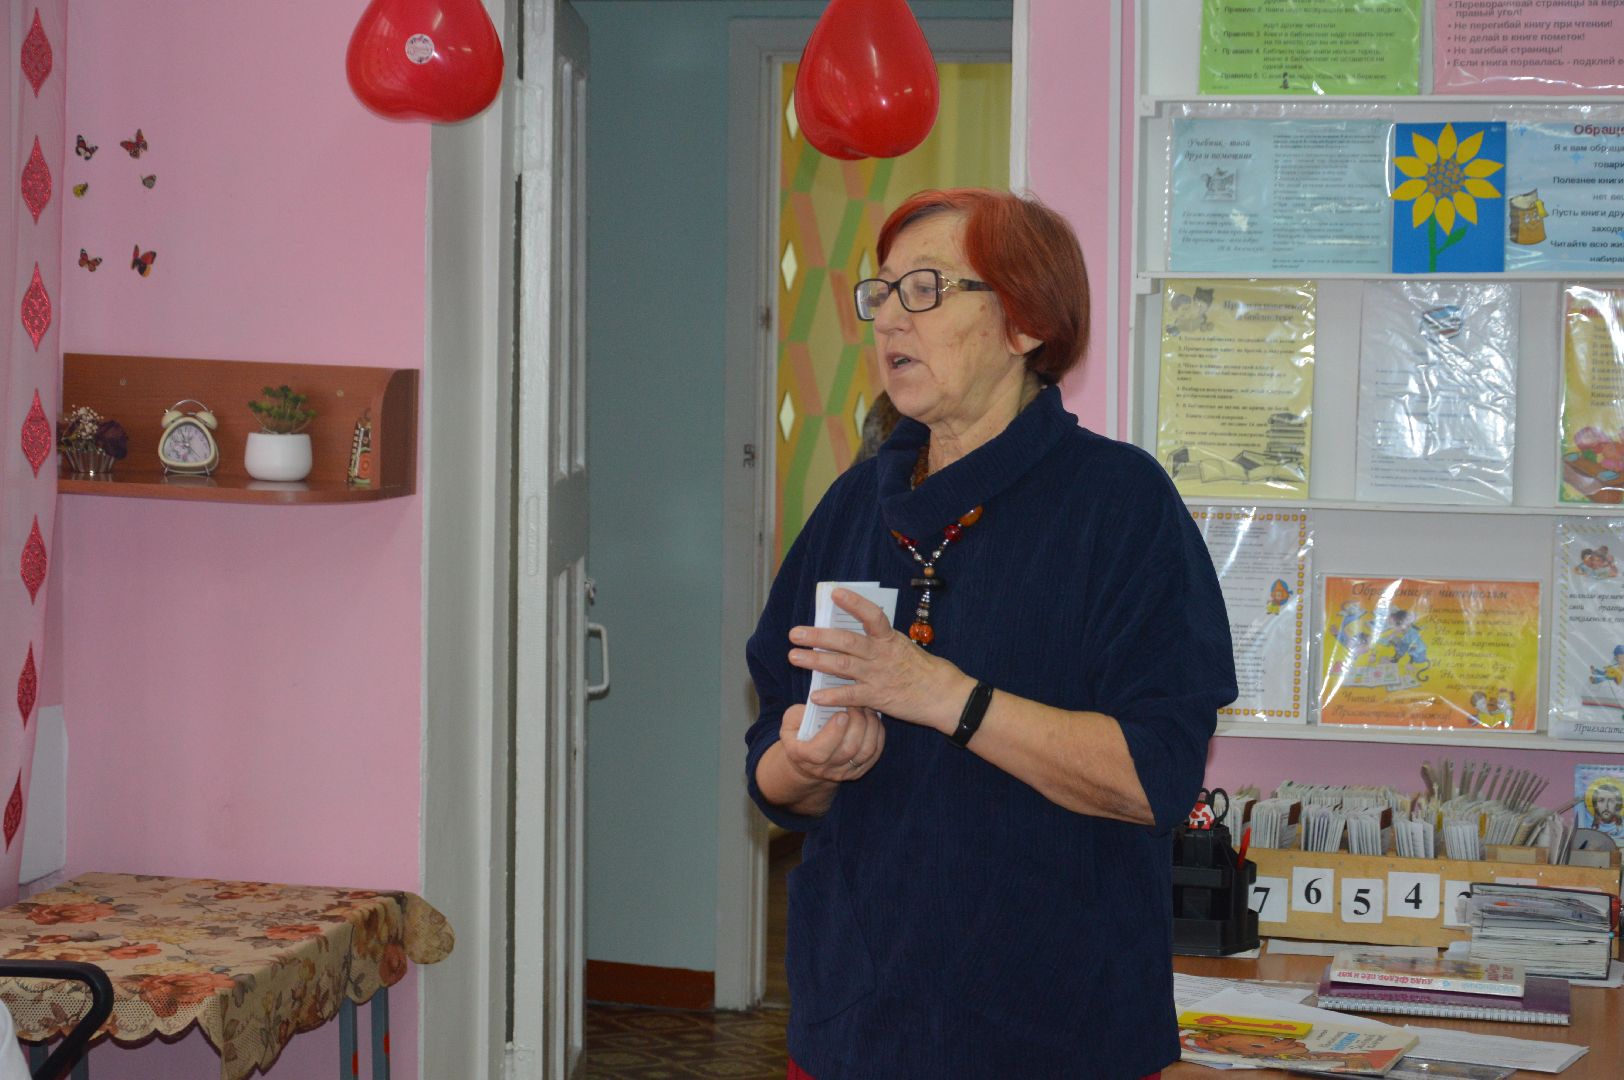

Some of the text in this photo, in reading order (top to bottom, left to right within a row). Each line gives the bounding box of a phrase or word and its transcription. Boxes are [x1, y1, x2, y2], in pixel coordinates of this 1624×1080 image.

[1455, 8, 1523, 18] правый угол!
[1454, 20, 1613, 31] Не перегибай книгу при чтении!
[1454, 34, 1467, 42] Не
[1469, 33, 1500, 43] делай
[1511, 33, 1538, 41] книге
[1540, 33, 1585, 41] пометок!
[1453, 44, 1563, 55] Не загибай страницы!
[1510, 59, 1564, 68] порвалась
[1573, 56, 1615, 67] подклей
[1553, 143, 1561, 152] Я
[1553, 176, 1596, 184] Полезнее
[1552, 208, 1579, 218] Пусть
[1550, 239, 1587, 249] Читайте
[1589, 241, 1608, 249] всю
[1252, 877, 1423, 916] 7 6 5 4
